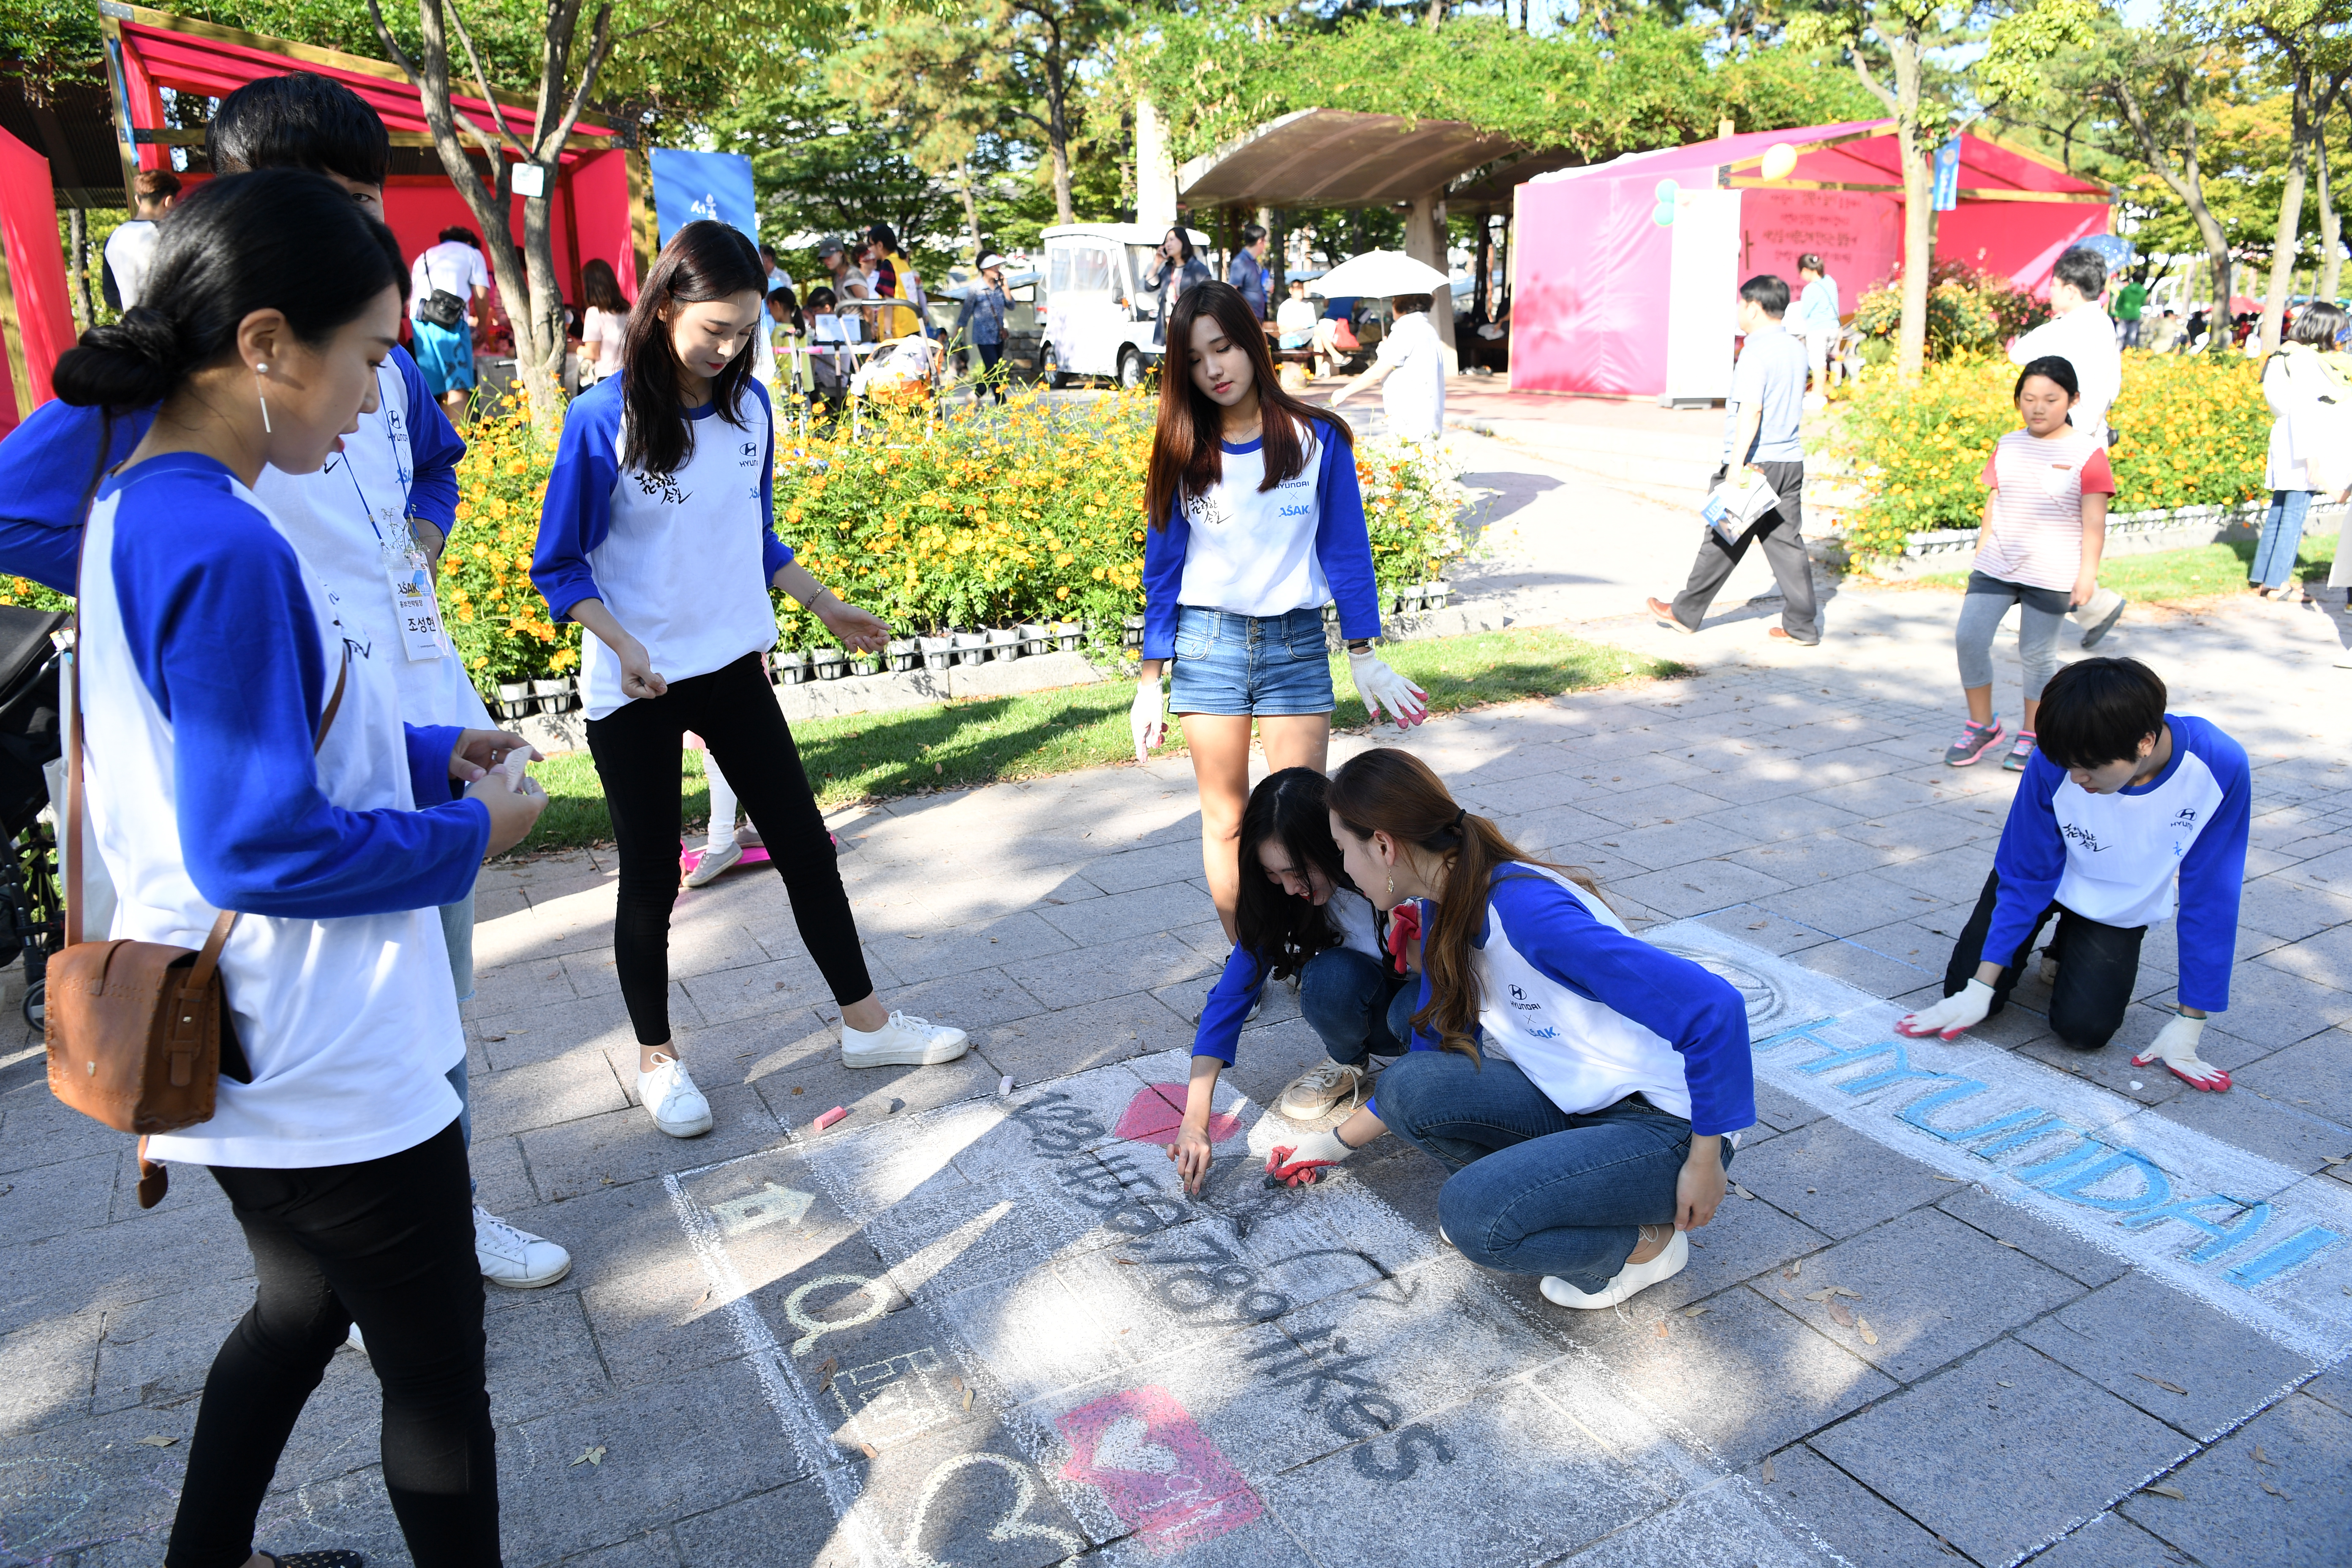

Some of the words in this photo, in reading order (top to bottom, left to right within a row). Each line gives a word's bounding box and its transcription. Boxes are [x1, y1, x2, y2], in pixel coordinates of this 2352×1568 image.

[691, 193, 718, 220] 서울
[1274, 481, 1309, 490] HYUNDAI
[408, 616, 436, 633] 조성현
[1510, 1000, 1541, 1010] HYUNDAI
[1753, 1017, 2340, 1290] HYUNDAI
[1241, 1323, 1456, 1481] likes
